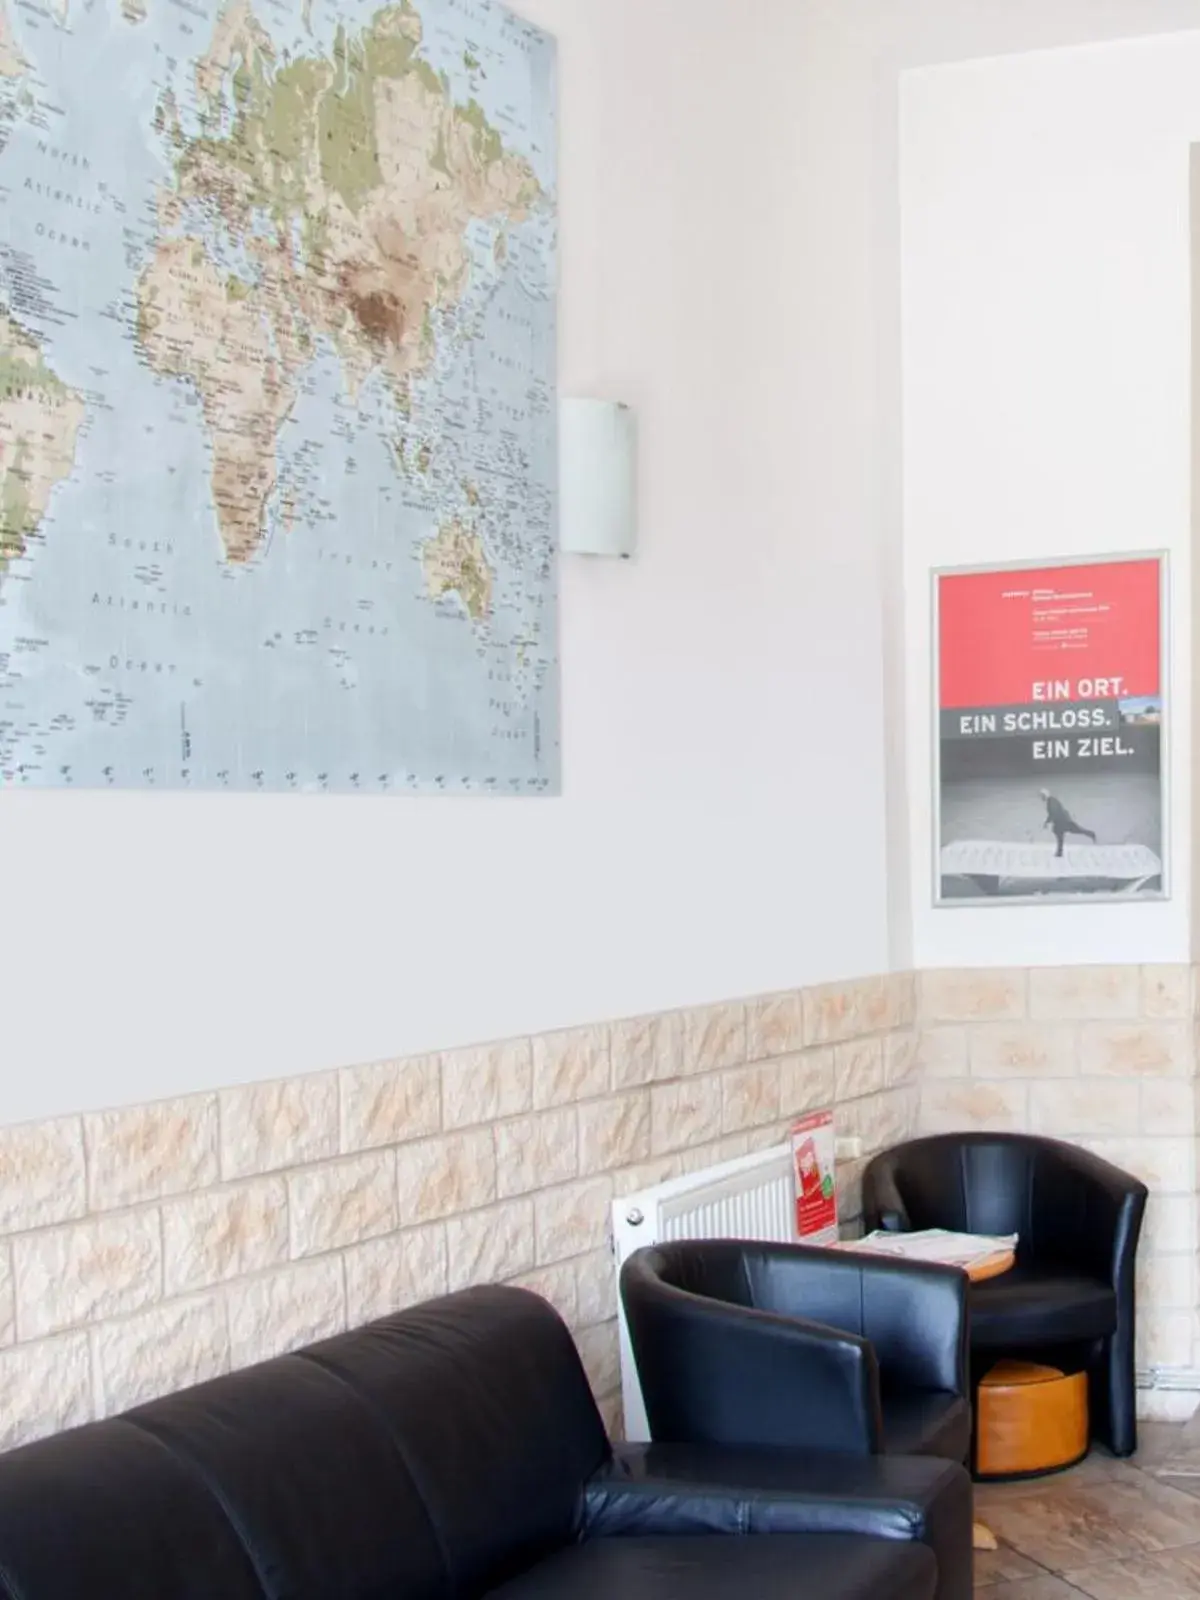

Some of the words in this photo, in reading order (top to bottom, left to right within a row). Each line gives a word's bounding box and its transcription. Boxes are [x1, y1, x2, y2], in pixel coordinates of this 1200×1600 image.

[37, 140, 90, 169] North
[24, 177, 102, 214] Atlantic
[92, 592, 191, 616] Atlantic
[1032, 680, 1069, 700] EIN
[1078, 677, 1128, 698] ORT.
[960, 714, 996, 734] EIN
[1003, 708, 1112, 731] SCHLOSS.
[1032, 740, 1070, 759] EIN
[1077, 737, 1134, 757] ZIEL.
